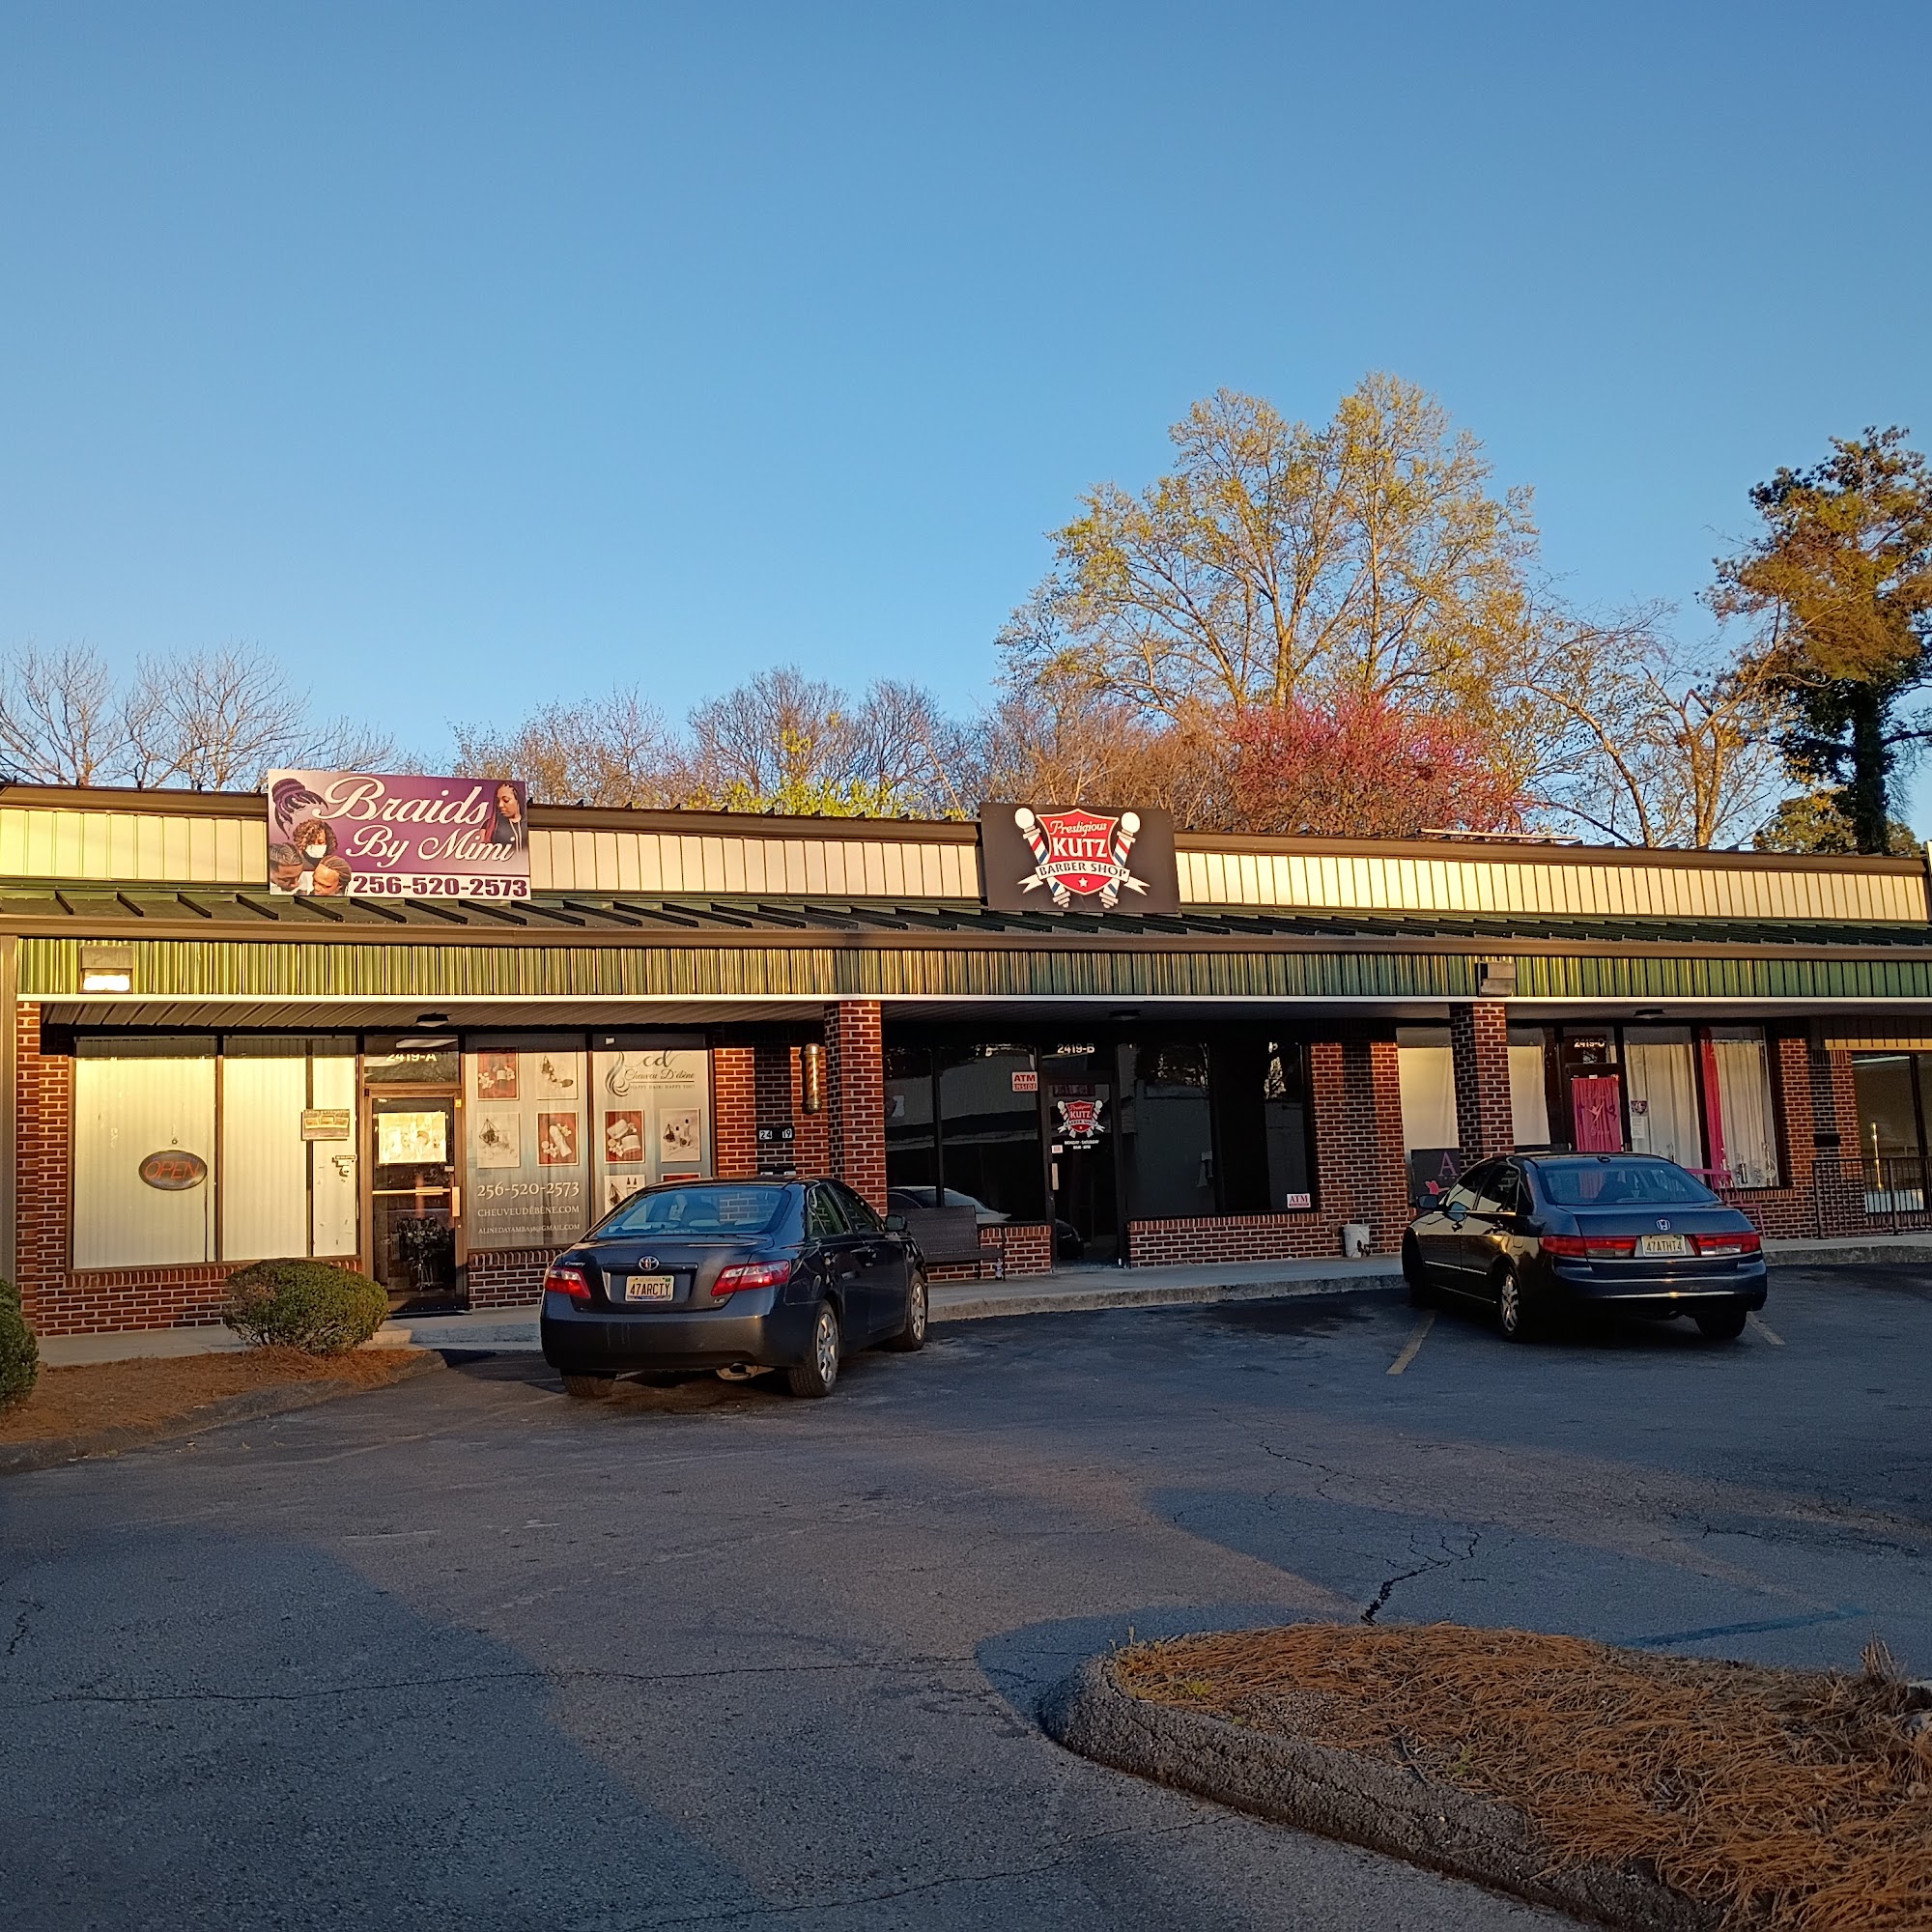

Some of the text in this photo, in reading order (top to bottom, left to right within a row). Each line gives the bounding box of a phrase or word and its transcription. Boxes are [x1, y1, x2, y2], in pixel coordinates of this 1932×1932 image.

[312, 776, 490, 825] Braids
[1050, 820, 1107, 837] Prestigious
[345, 825, 516, 867] By Mimi
[1052, 837, 1108, 858] KUTZ
[1038, 862, 1126, 878] BARBER SHOP
[353, 875, 527, 897] 256-520-2573
[1069, 1110, 1092, 1119] KUTZ
[782, 1129, 792, 1138] 19
[145, 1160, 200, 1179] OPEN
[477, 1181, 580, 1200] 256-520-2573
[630, 1283, 670, 1295] 47ARCTY
